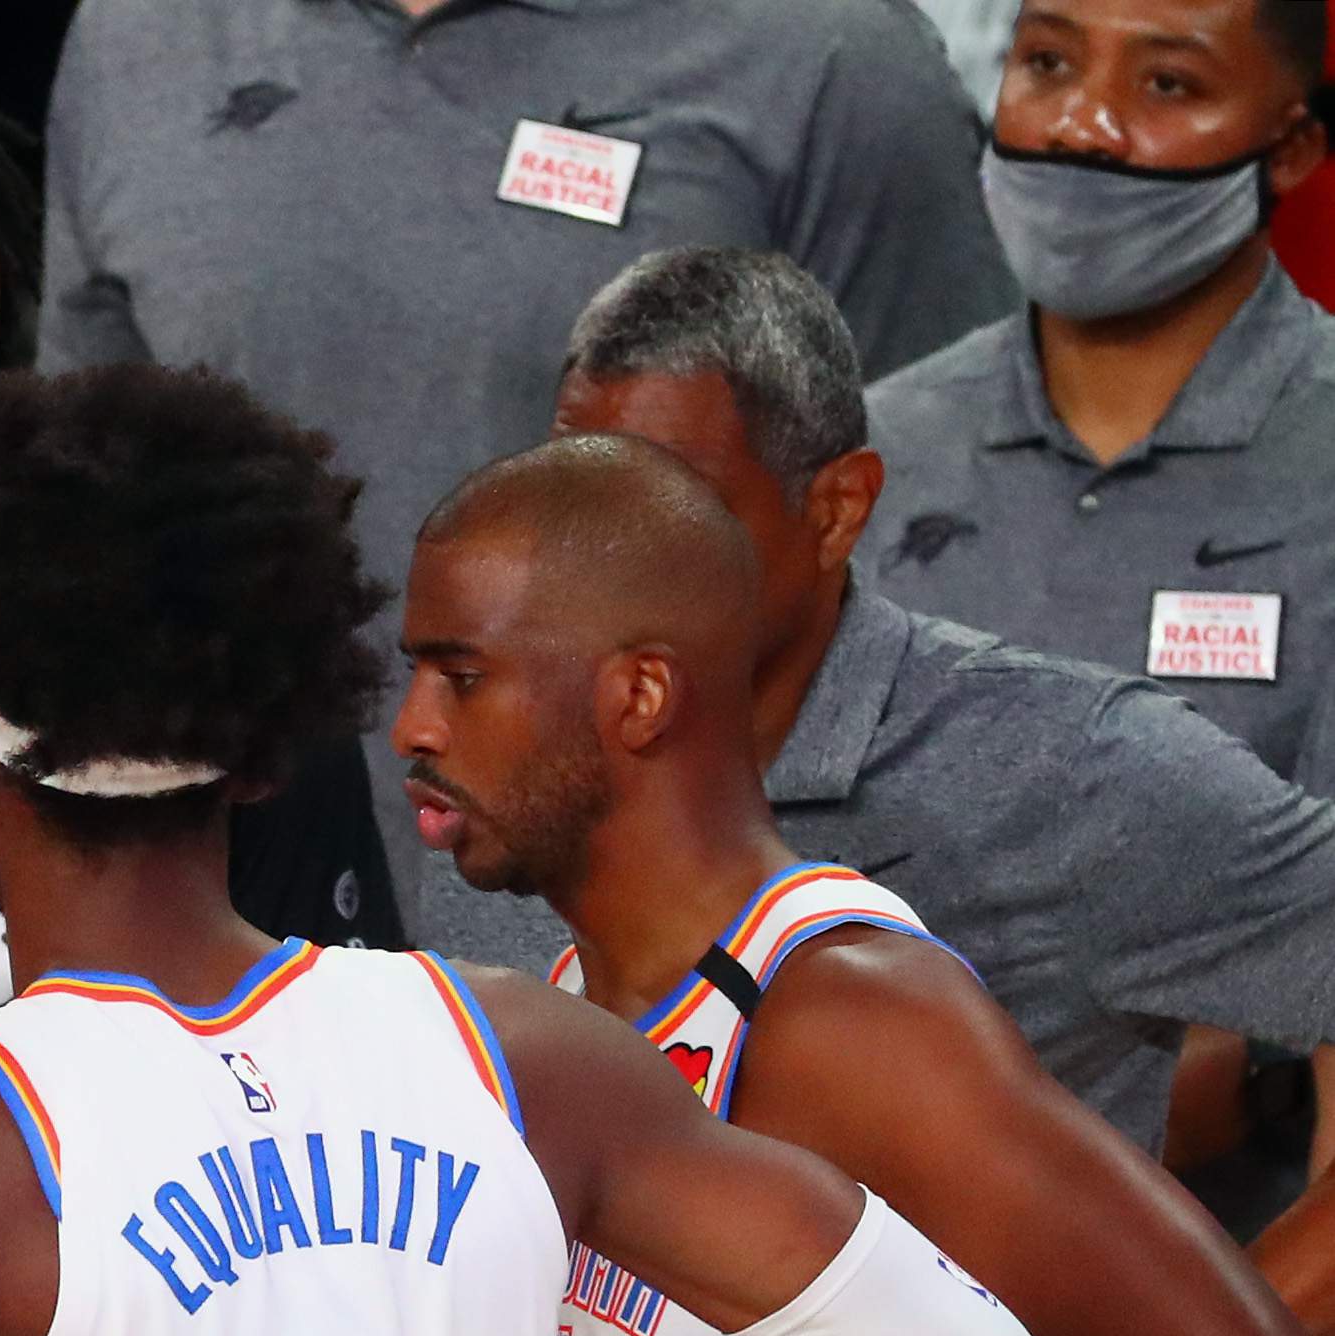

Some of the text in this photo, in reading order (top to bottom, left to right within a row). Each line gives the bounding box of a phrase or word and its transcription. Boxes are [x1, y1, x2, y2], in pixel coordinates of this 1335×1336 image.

[519, 150, 616, 192] RACIAL
[1164, 623, 1261, 647] RACIAL
[121, 1130, 480, 1316] EQUALITY
